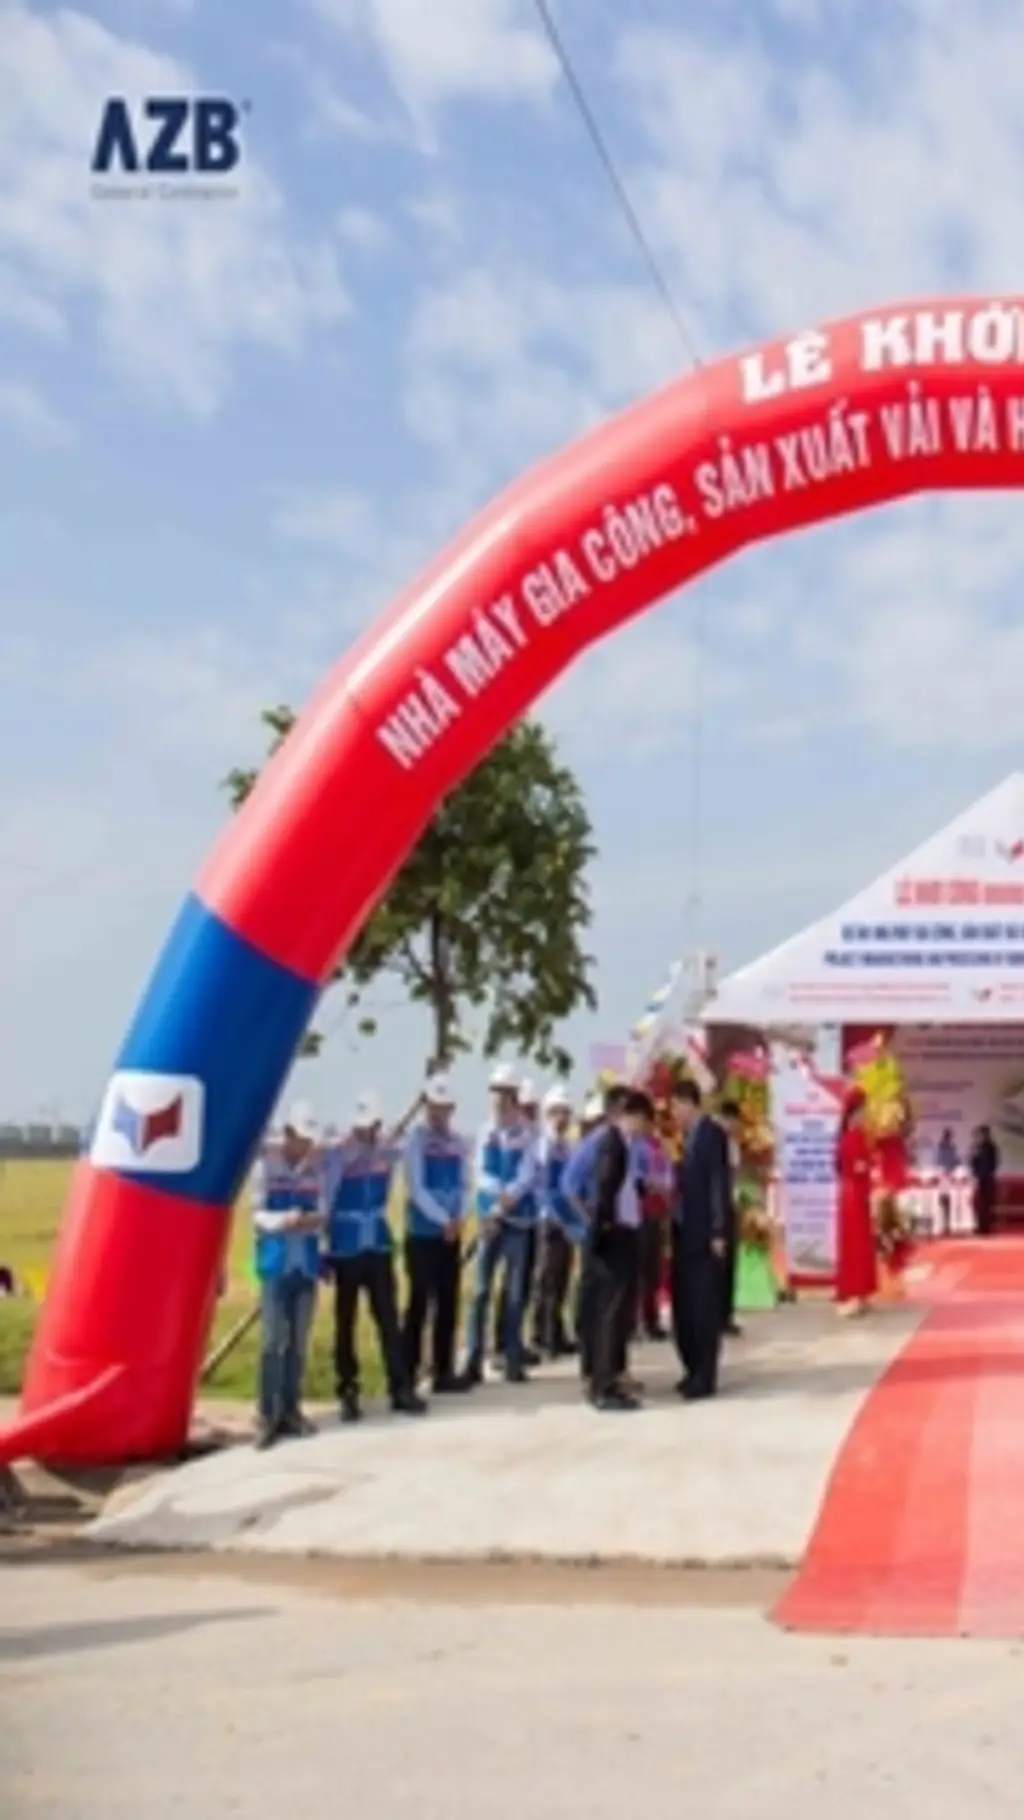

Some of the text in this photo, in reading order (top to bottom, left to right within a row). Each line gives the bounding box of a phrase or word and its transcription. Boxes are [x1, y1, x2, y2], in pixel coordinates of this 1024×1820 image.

[375, 664, 462, 769] NHÀ
[442, 592, 528, 697] MÁY
[521, 549, 591, 627] GIA
[949, 384, 998, 452] VÀ
